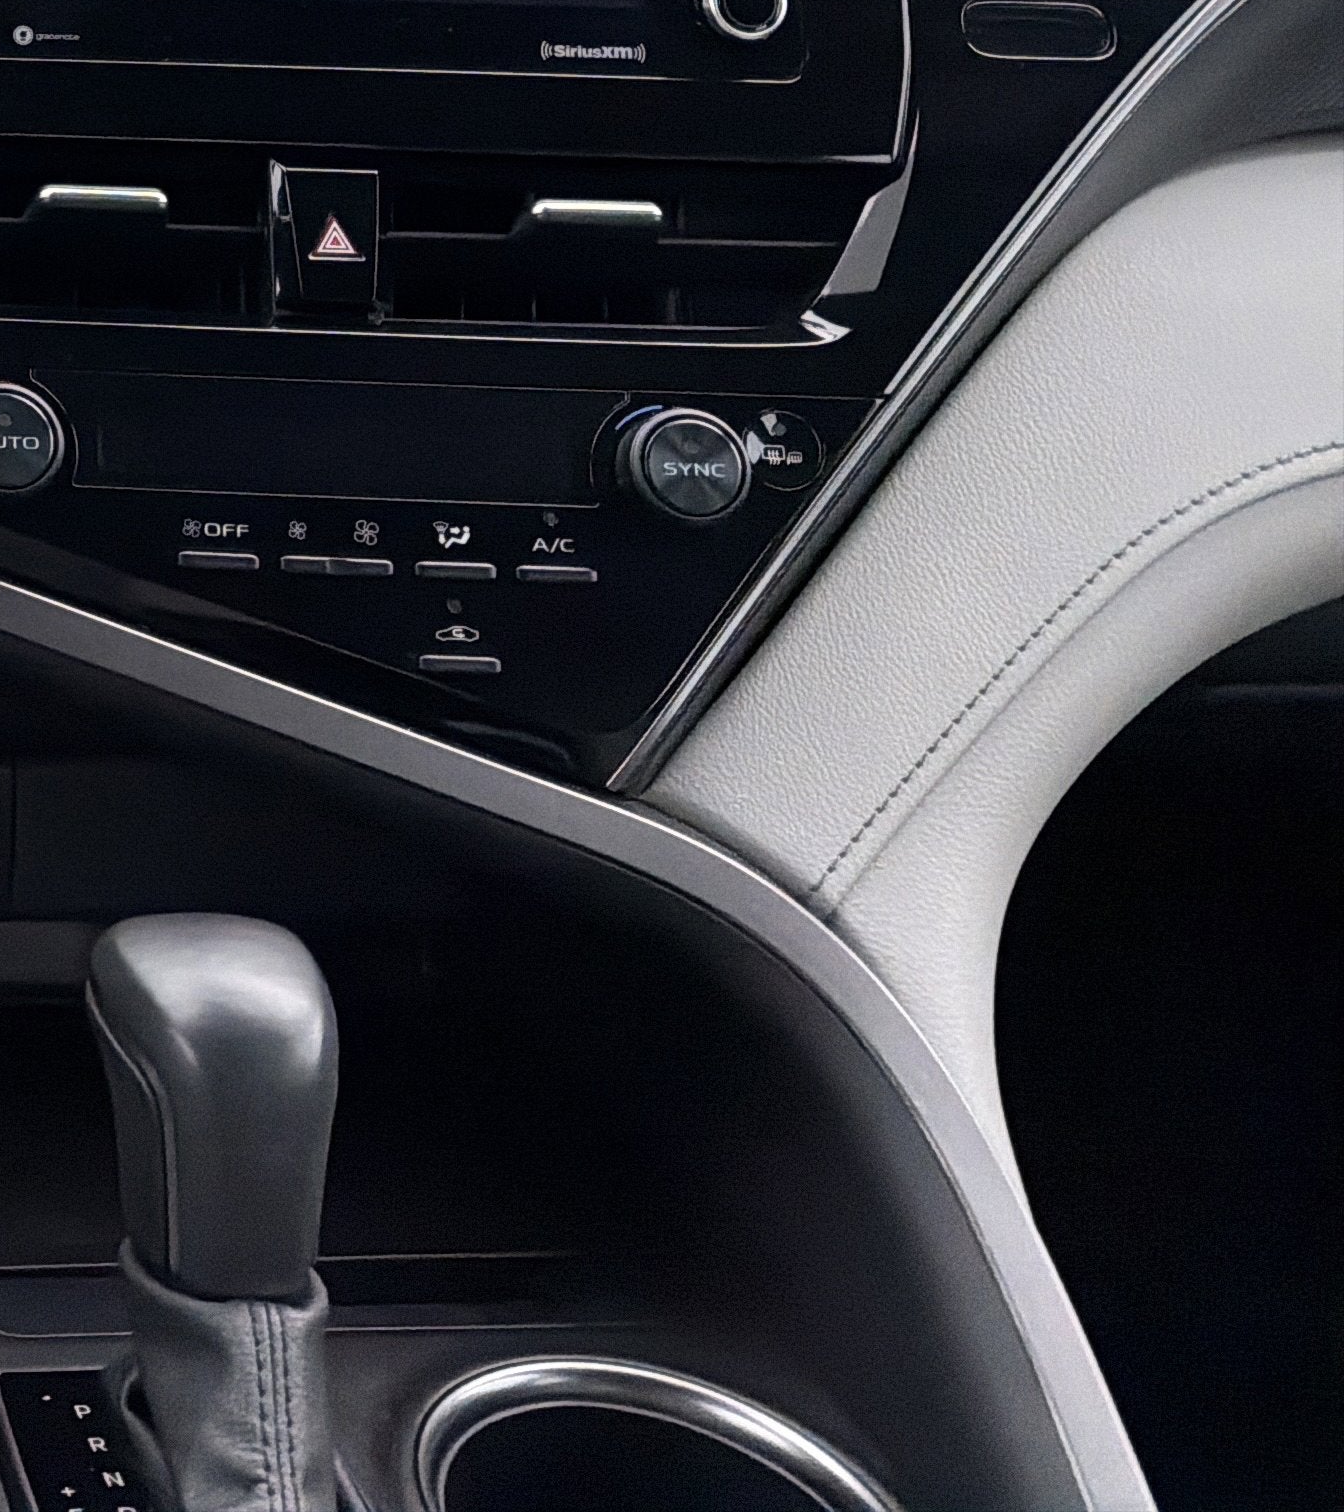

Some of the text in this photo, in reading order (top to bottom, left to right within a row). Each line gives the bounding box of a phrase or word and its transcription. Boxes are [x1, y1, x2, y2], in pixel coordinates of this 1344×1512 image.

[662, 461, 726, 479] SYNC
[203, 522, 250, 539] OFF
[531, 537, 576, 554] A/C
[73, 1404, 92, 1419] P
[87, 1436, 109, 1453] R
[101, 1471, 126, 1488] N
